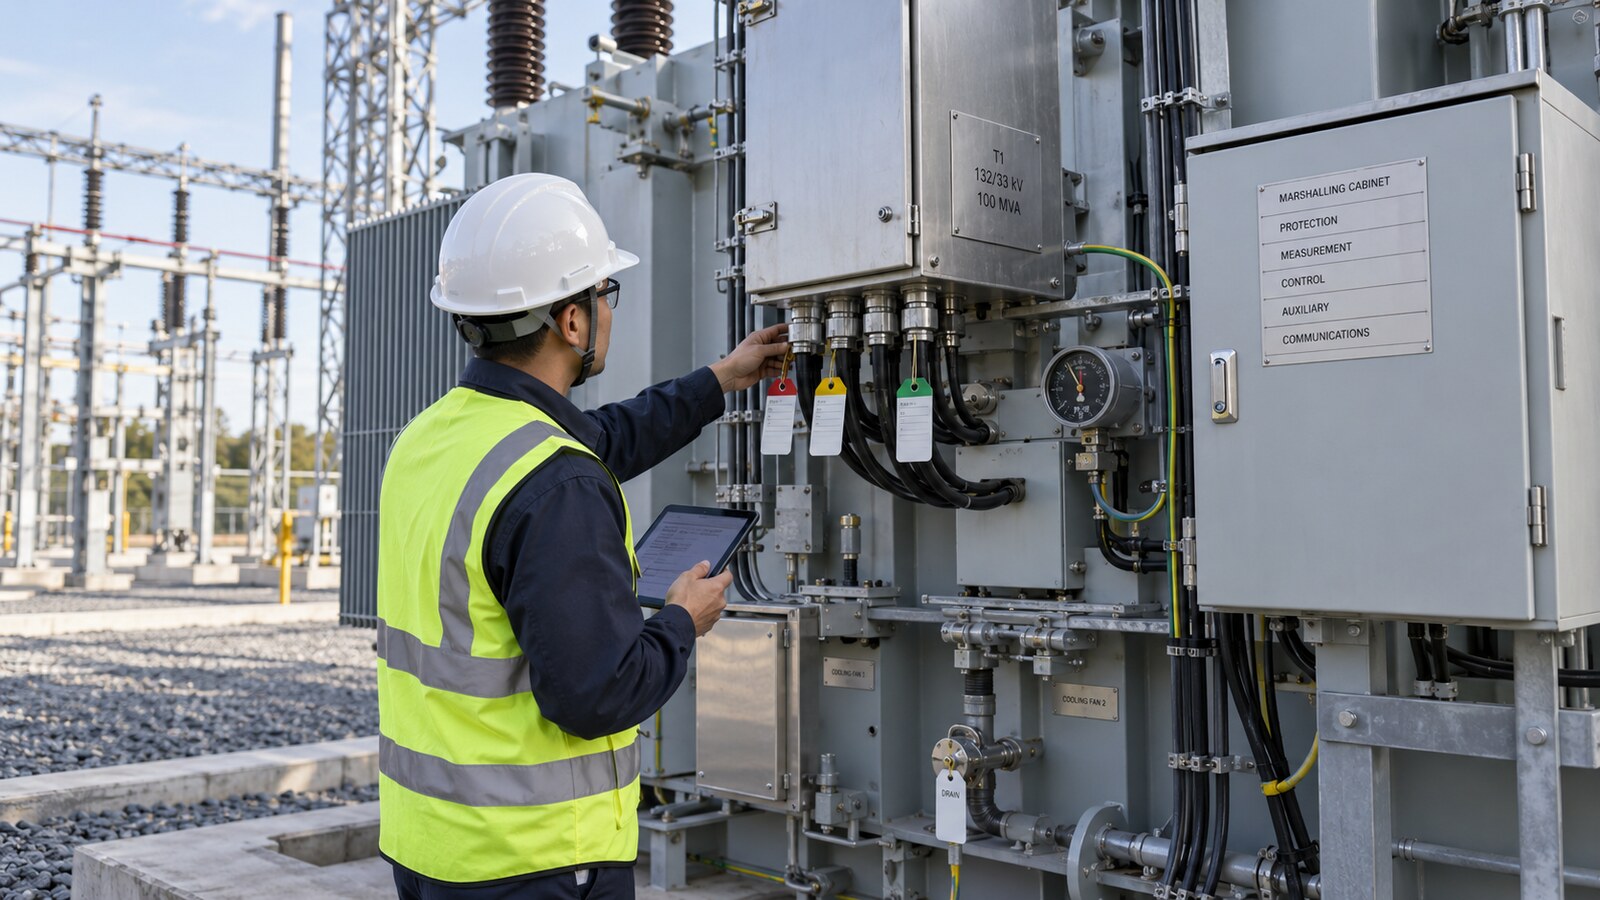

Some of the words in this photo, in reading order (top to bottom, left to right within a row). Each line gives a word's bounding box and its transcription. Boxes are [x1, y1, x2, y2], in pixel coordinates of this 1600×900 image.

[993, 149, 1004, 164] T1
[975, 167, 1008, 189] 132/33
[1011, 177, 1023, 192] kV
[1279, 184, 1346, 202] MARSHALLING
[1348, 176, 1390, 192] CABINET
[977, 192, 995, 209] 100
[999, 197, 1021, 215] MVA
[1280, 215, 1338, 233] PROTECTION
[1280, 242, 1352, 260] MEASUREMENT
[1281, 274, 1325, 288] CONTROL
[1282, 302, 1329, 316] AUXILIARY
[1282, 327, 1370, 345] COMMUNICATIONS
[1062, 695, 1088, 705] COOLING
[1089, 697, 1101, 706] FAN
[1101, 699, 1106, 707] 2
[941, 789, 960, 799] DRAIN
